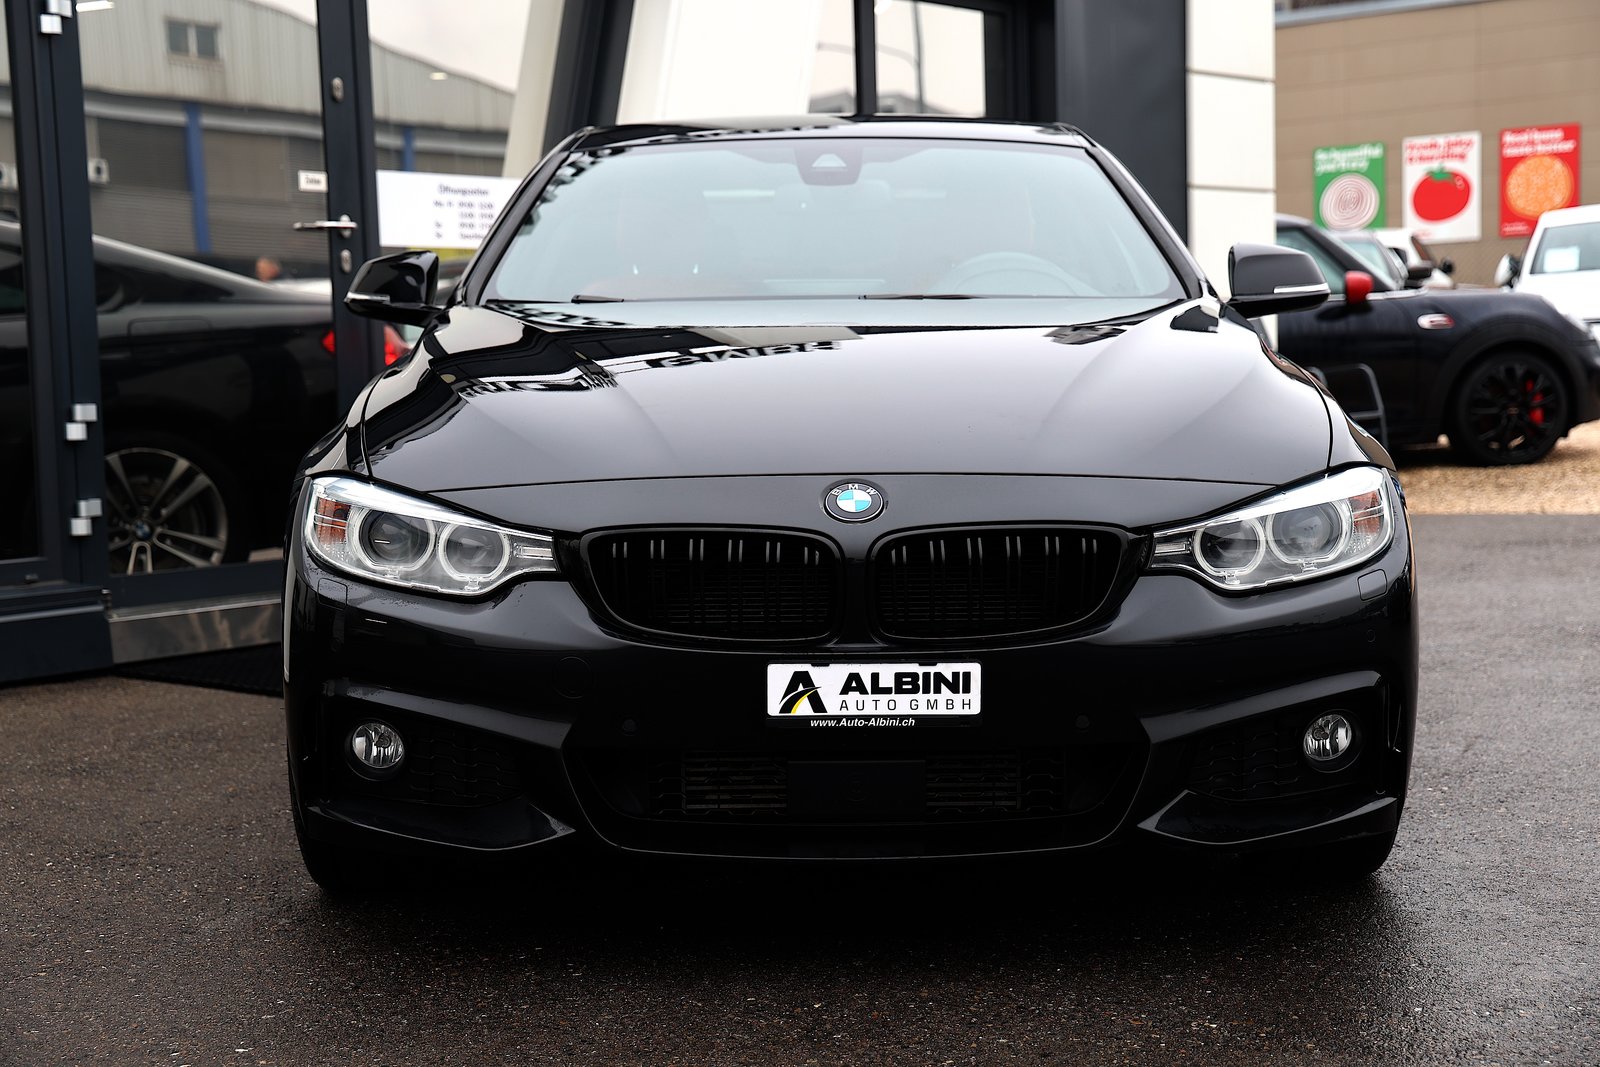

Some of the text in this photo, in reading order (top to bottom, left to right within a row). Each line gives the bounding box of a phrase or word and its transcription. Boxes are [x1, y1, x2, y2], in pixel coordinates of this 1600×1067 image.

[831, 483, 877, 497] BMW
[839, 671, 972, 696] ALBINI
[839, 698, 972, 711] AUTO GMBH
[810, 717, 915, 728] www.Auto-Albini.ch
